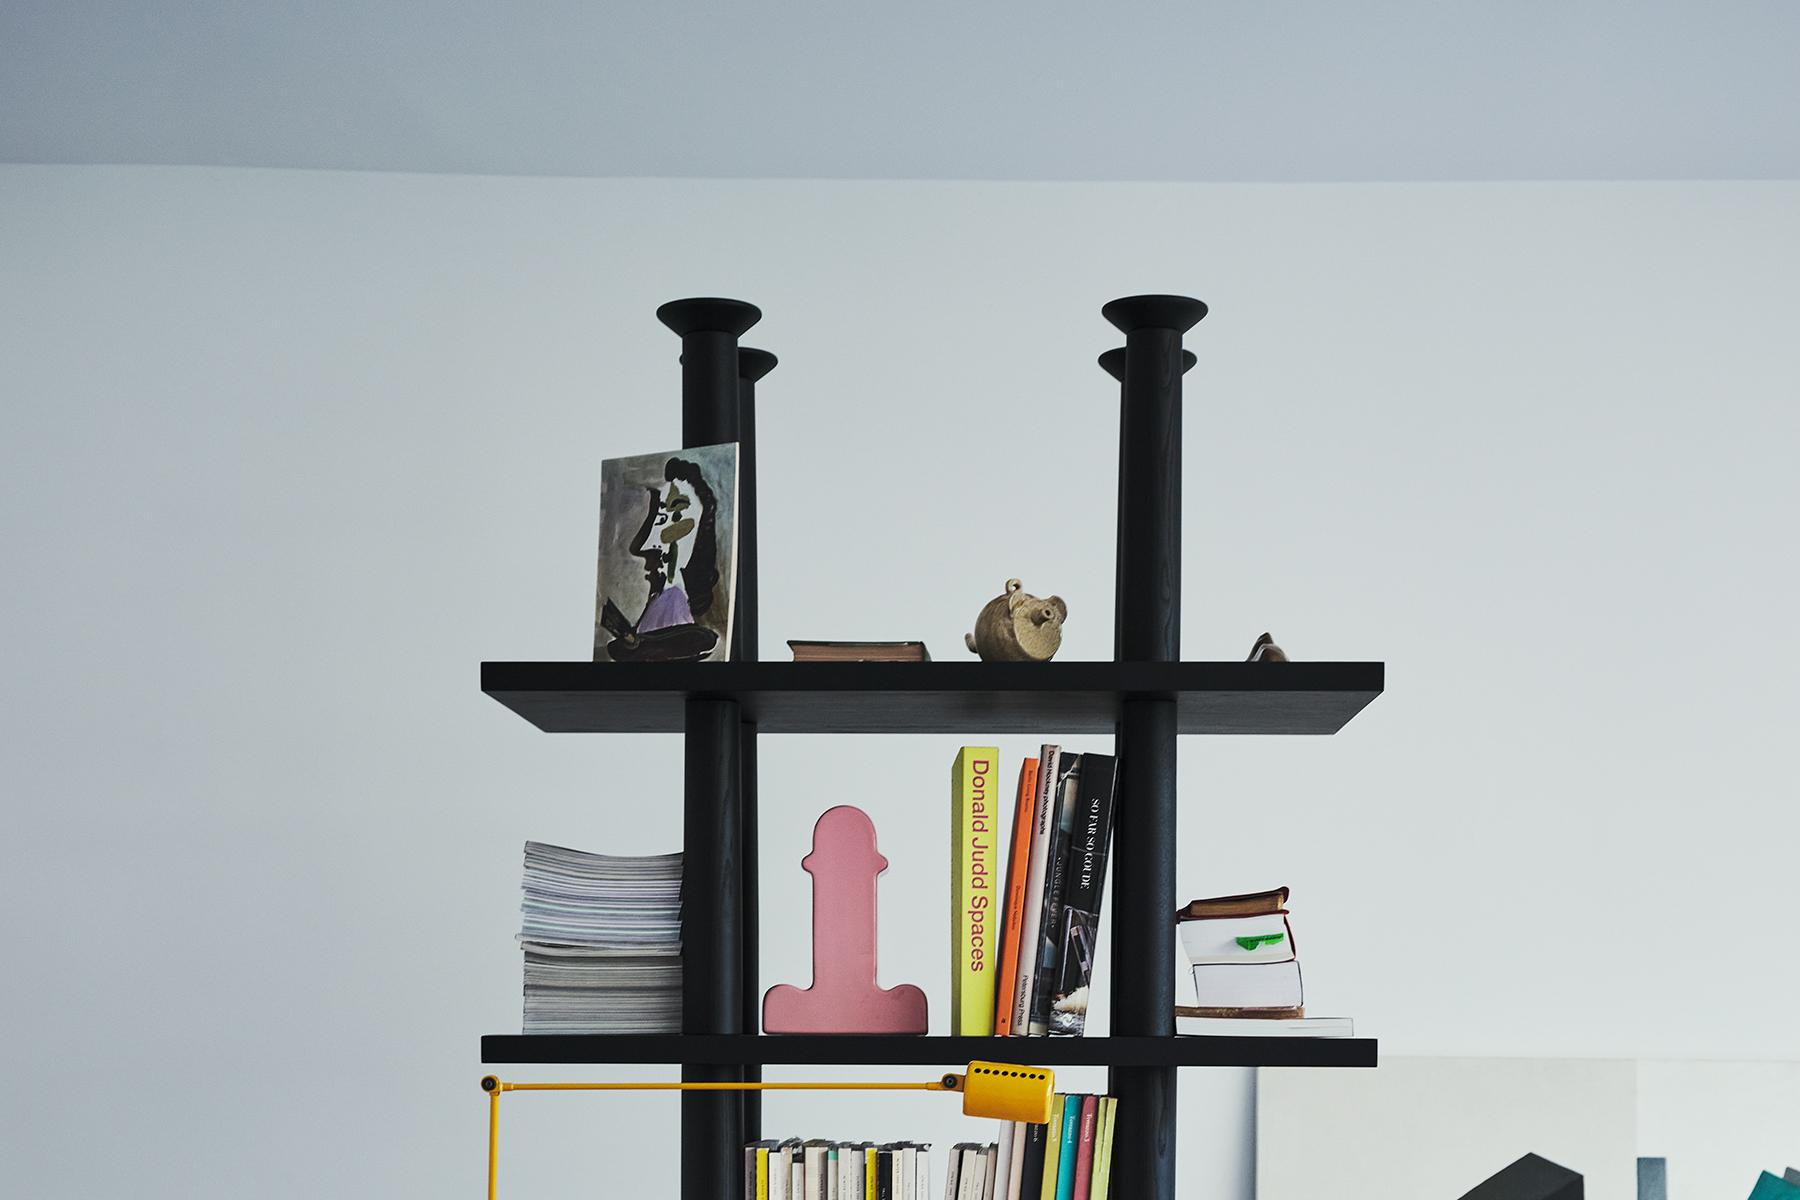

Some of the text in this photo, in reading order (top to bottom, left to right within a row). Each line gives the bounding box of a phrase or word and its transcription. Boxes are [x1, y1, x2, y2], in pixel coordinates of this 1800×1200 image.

[1090, 798, 1101, 813] SO
[1087, 815, 1098, 834] FAR
[1085, 836, 1096, 851] SO
[968, 760, 990, 972] Donald Judd Spaces
